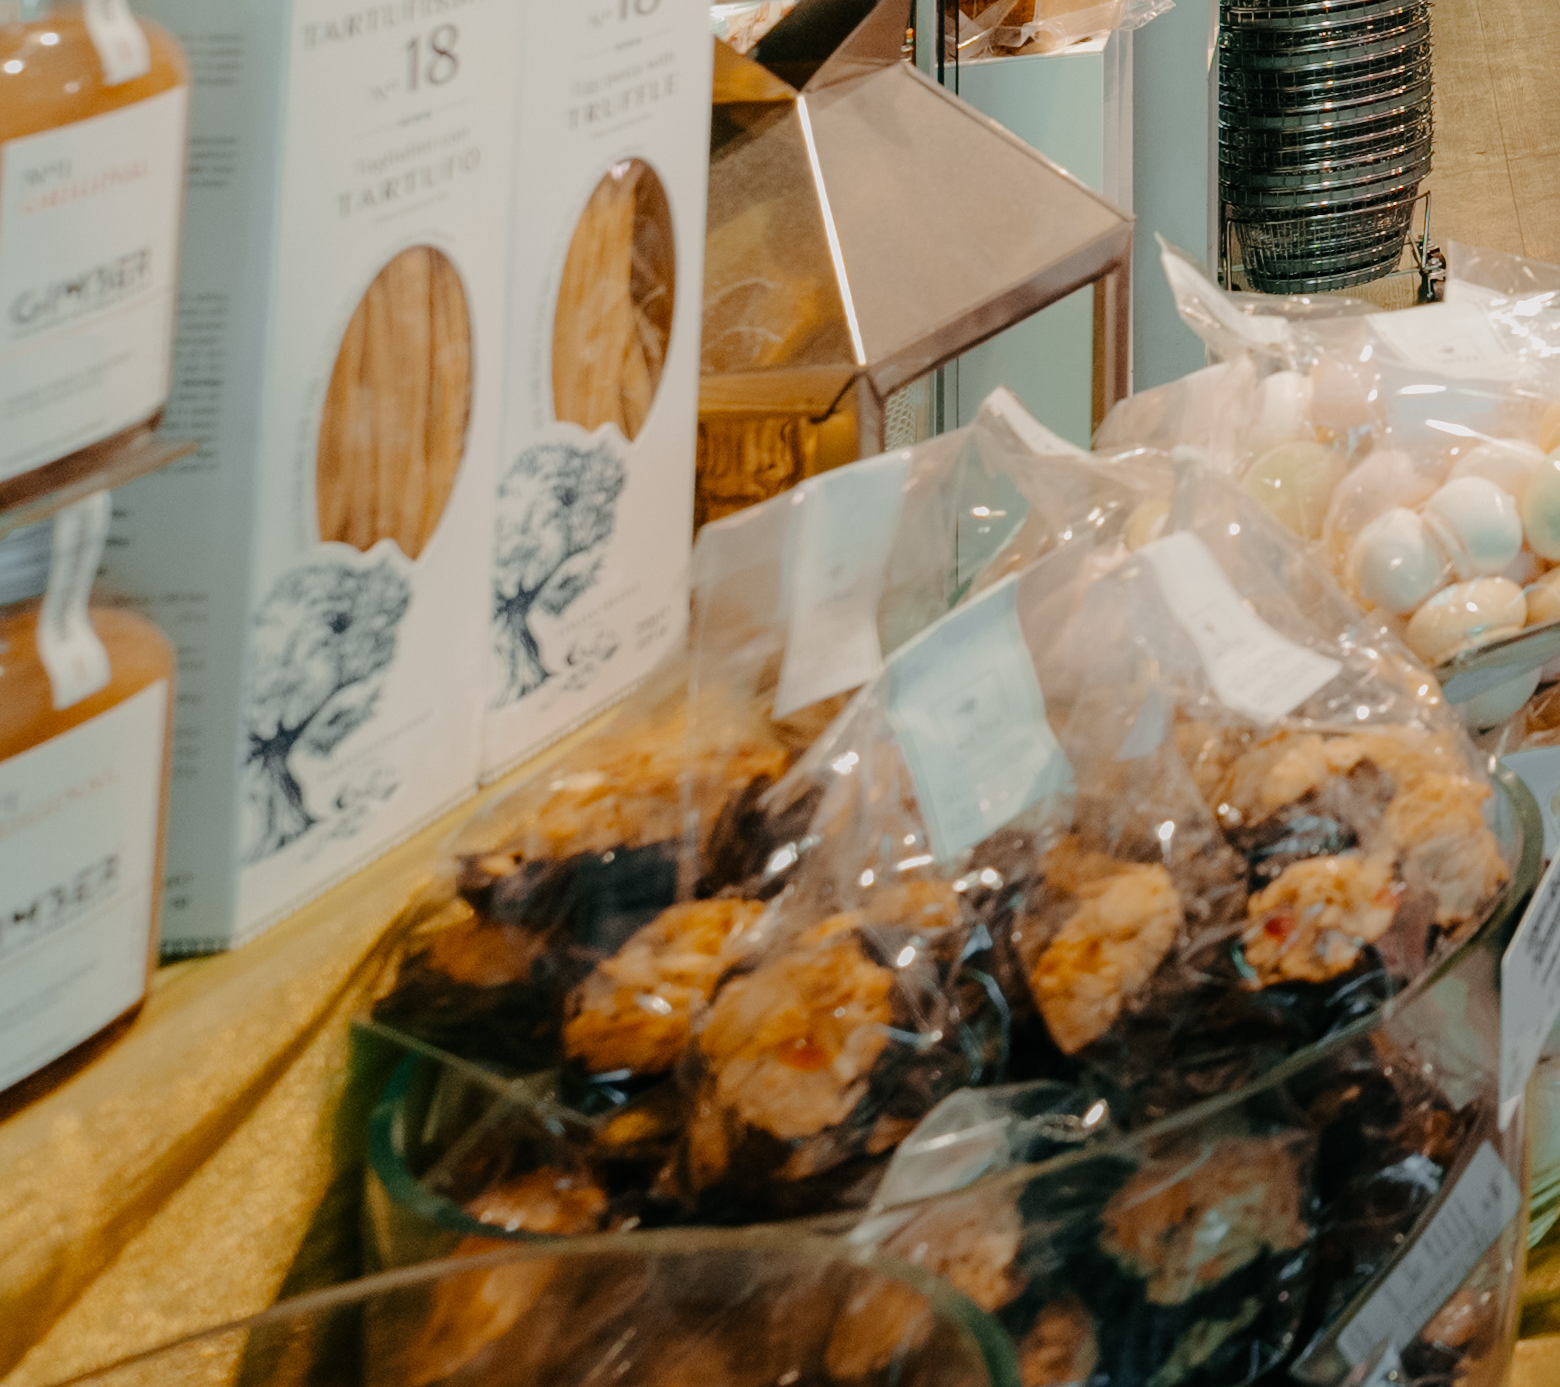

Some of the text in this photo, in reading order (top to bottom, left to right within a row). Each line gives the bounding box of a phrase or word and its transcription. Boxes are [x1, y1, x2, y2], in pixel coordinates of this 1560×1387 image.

[404, 22, 460, 94] 18
[567, 73, 680, 129] TRUFFLE
[335, 147, 481, 219] TARTUFO
